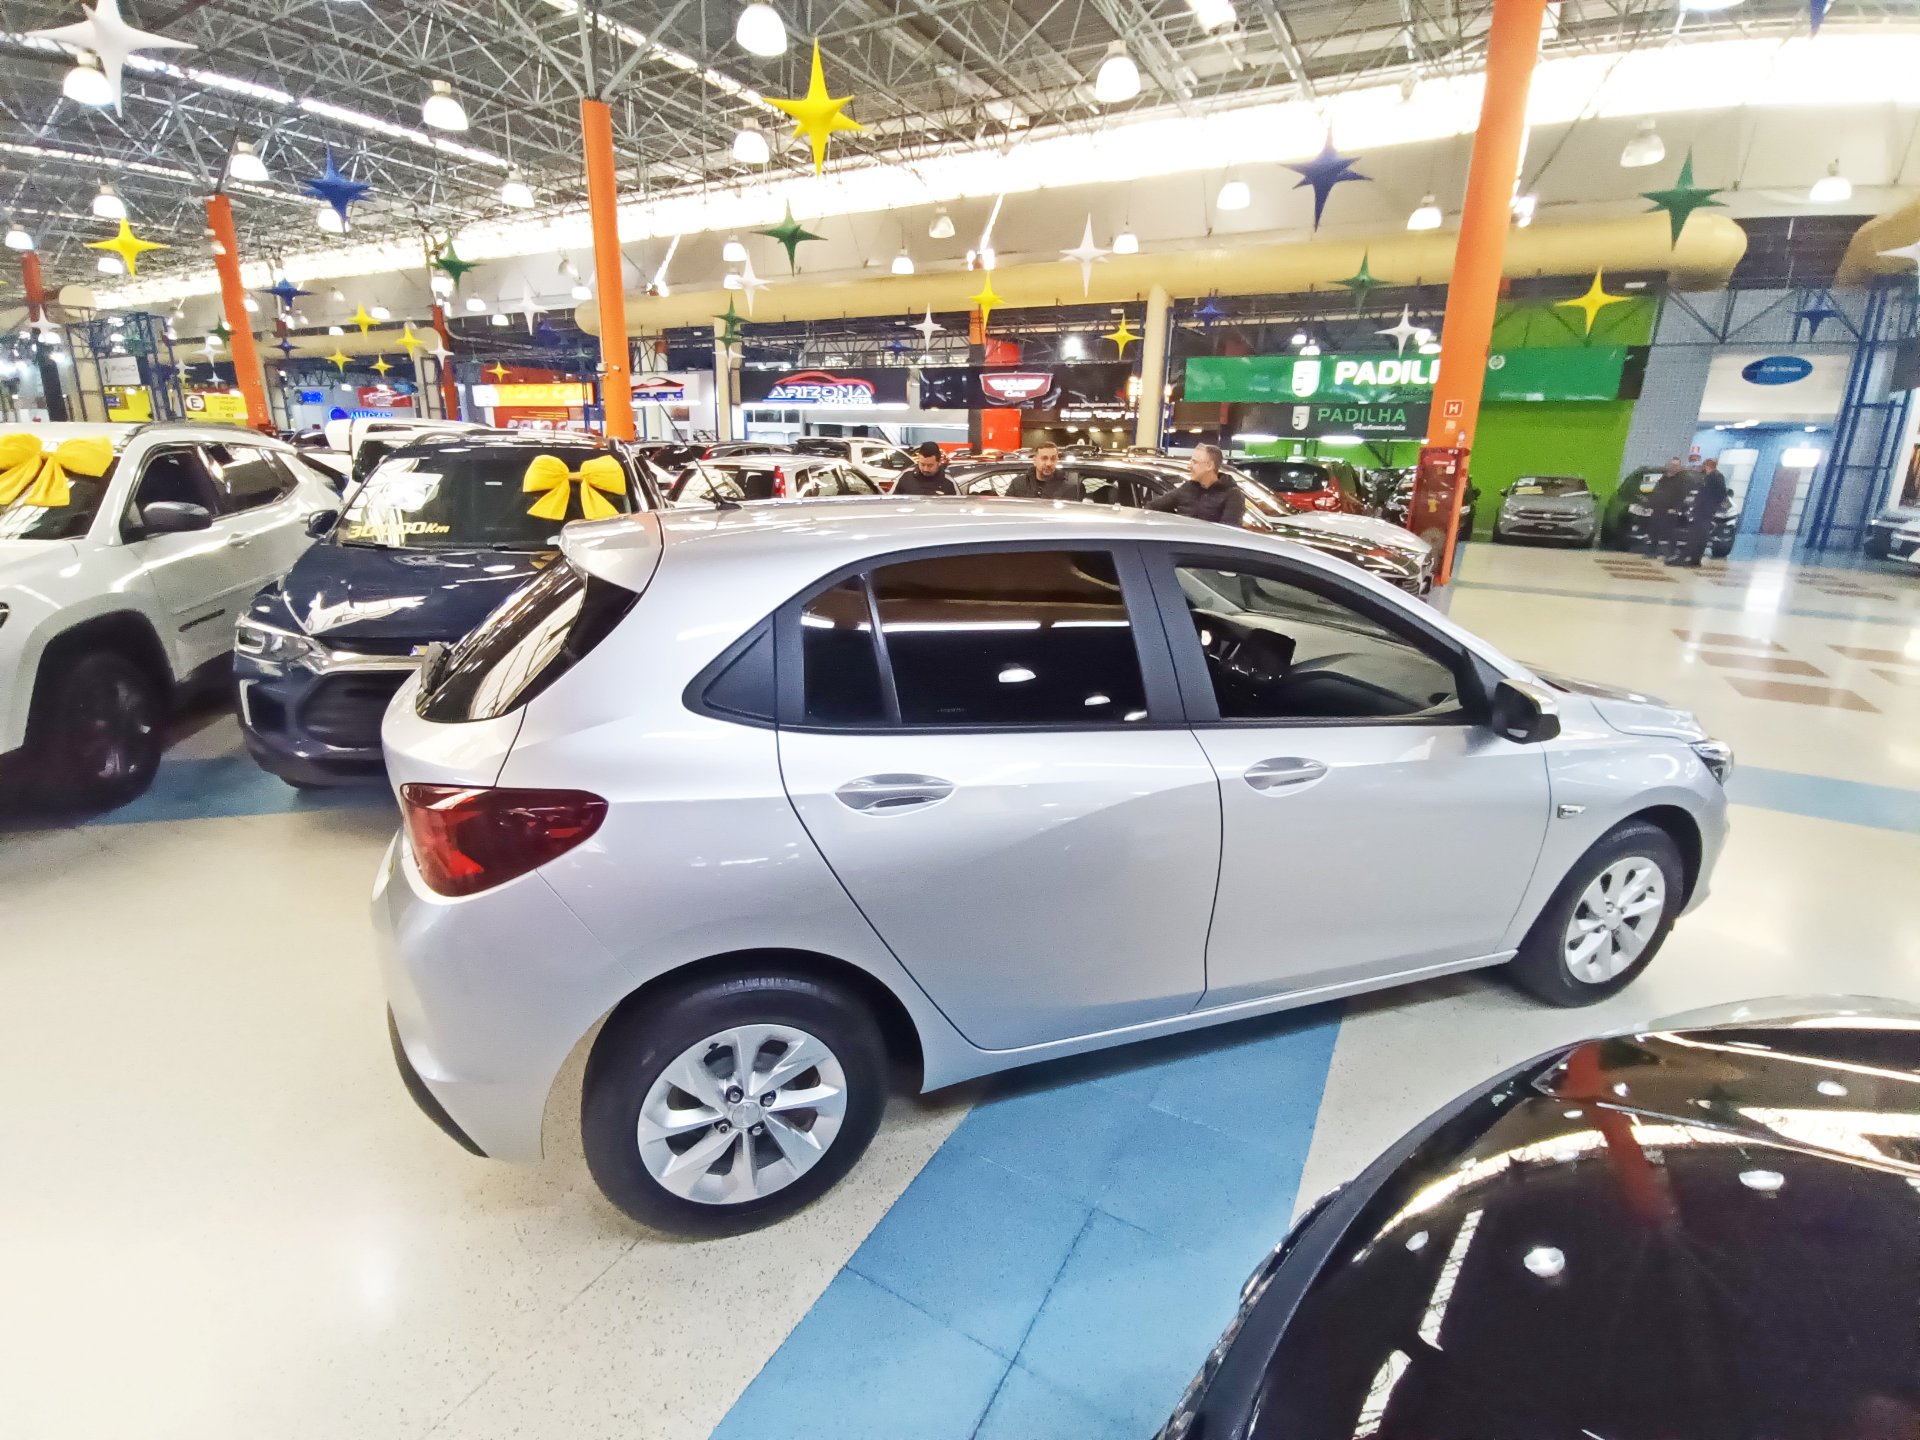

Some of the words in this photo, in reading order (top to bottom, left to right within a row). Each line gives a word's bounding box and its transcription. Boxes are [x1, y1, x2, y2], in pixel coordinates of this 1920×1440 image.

[768, 385, 872, 398] ARIZONA
[1317, 408, 1407, 423] PADILHA
[1449, 404, 1459, 414] H
